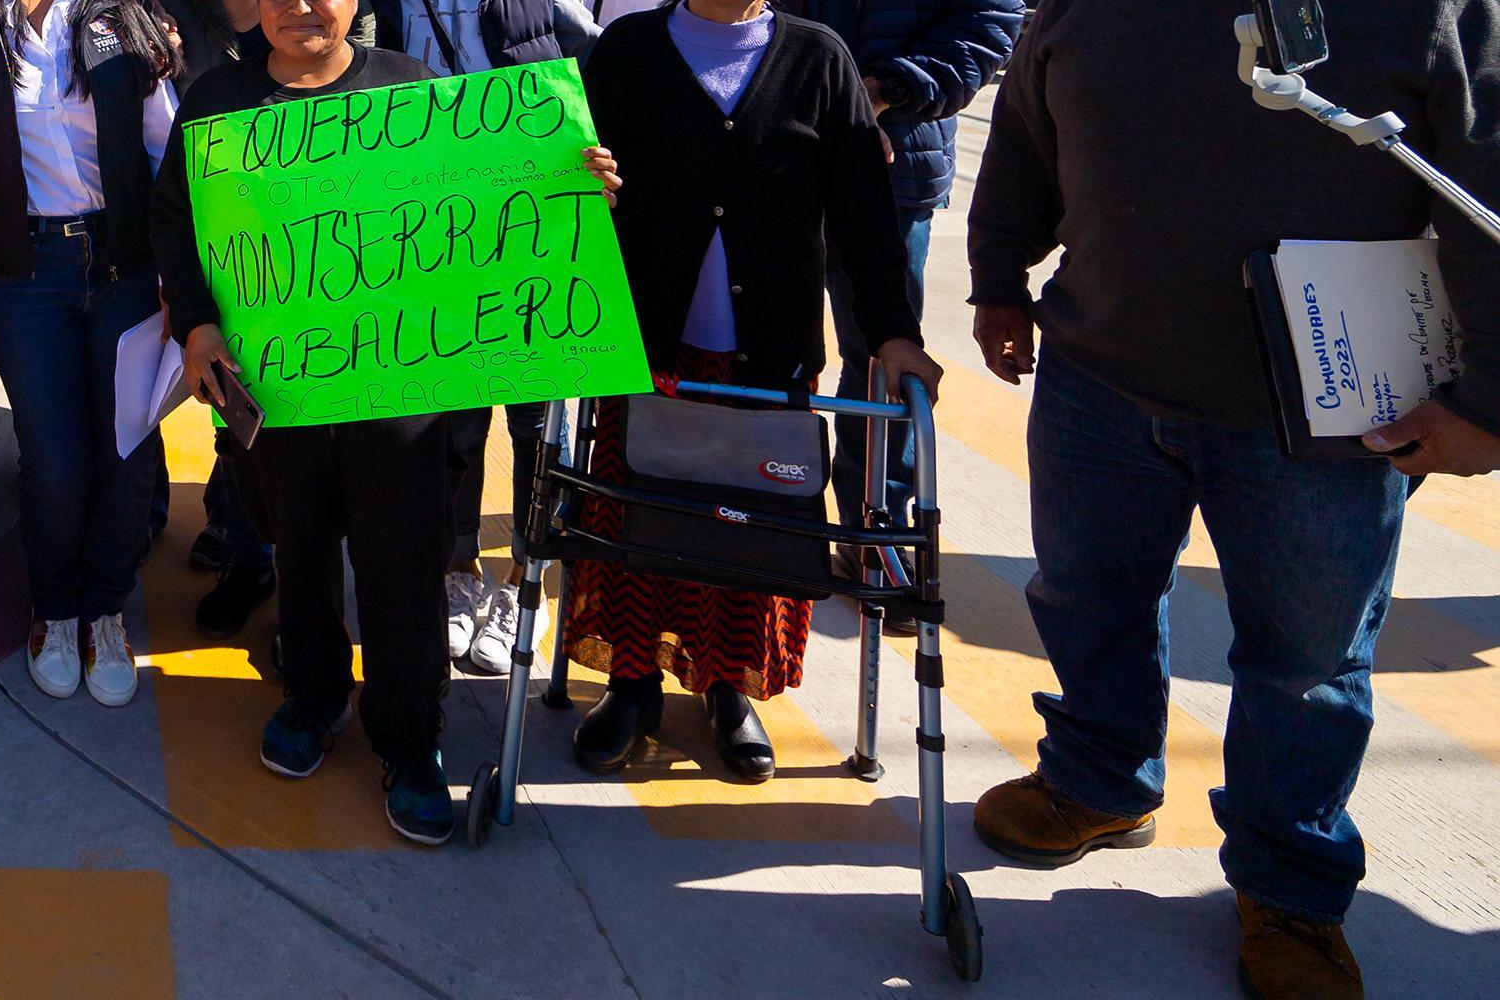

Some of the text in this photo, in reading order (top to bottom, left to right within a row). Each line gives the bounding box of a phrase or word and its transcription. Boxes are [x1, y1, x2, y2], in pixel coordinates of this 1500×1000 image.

[183, 70, 565, 181] TE QUEREMOS
[384, 156, 536, 191] Centenario
[491, 172, 545, 187] estamos
[208, 190, 605, 307] MONTSERRAT
[1303, 282, 1341, 409] COMUNIDADES
[1334, 338, 1356, 391] 2023
[766, 461, 805, 476] Carex
[719, 507, 748, 521] Carex
